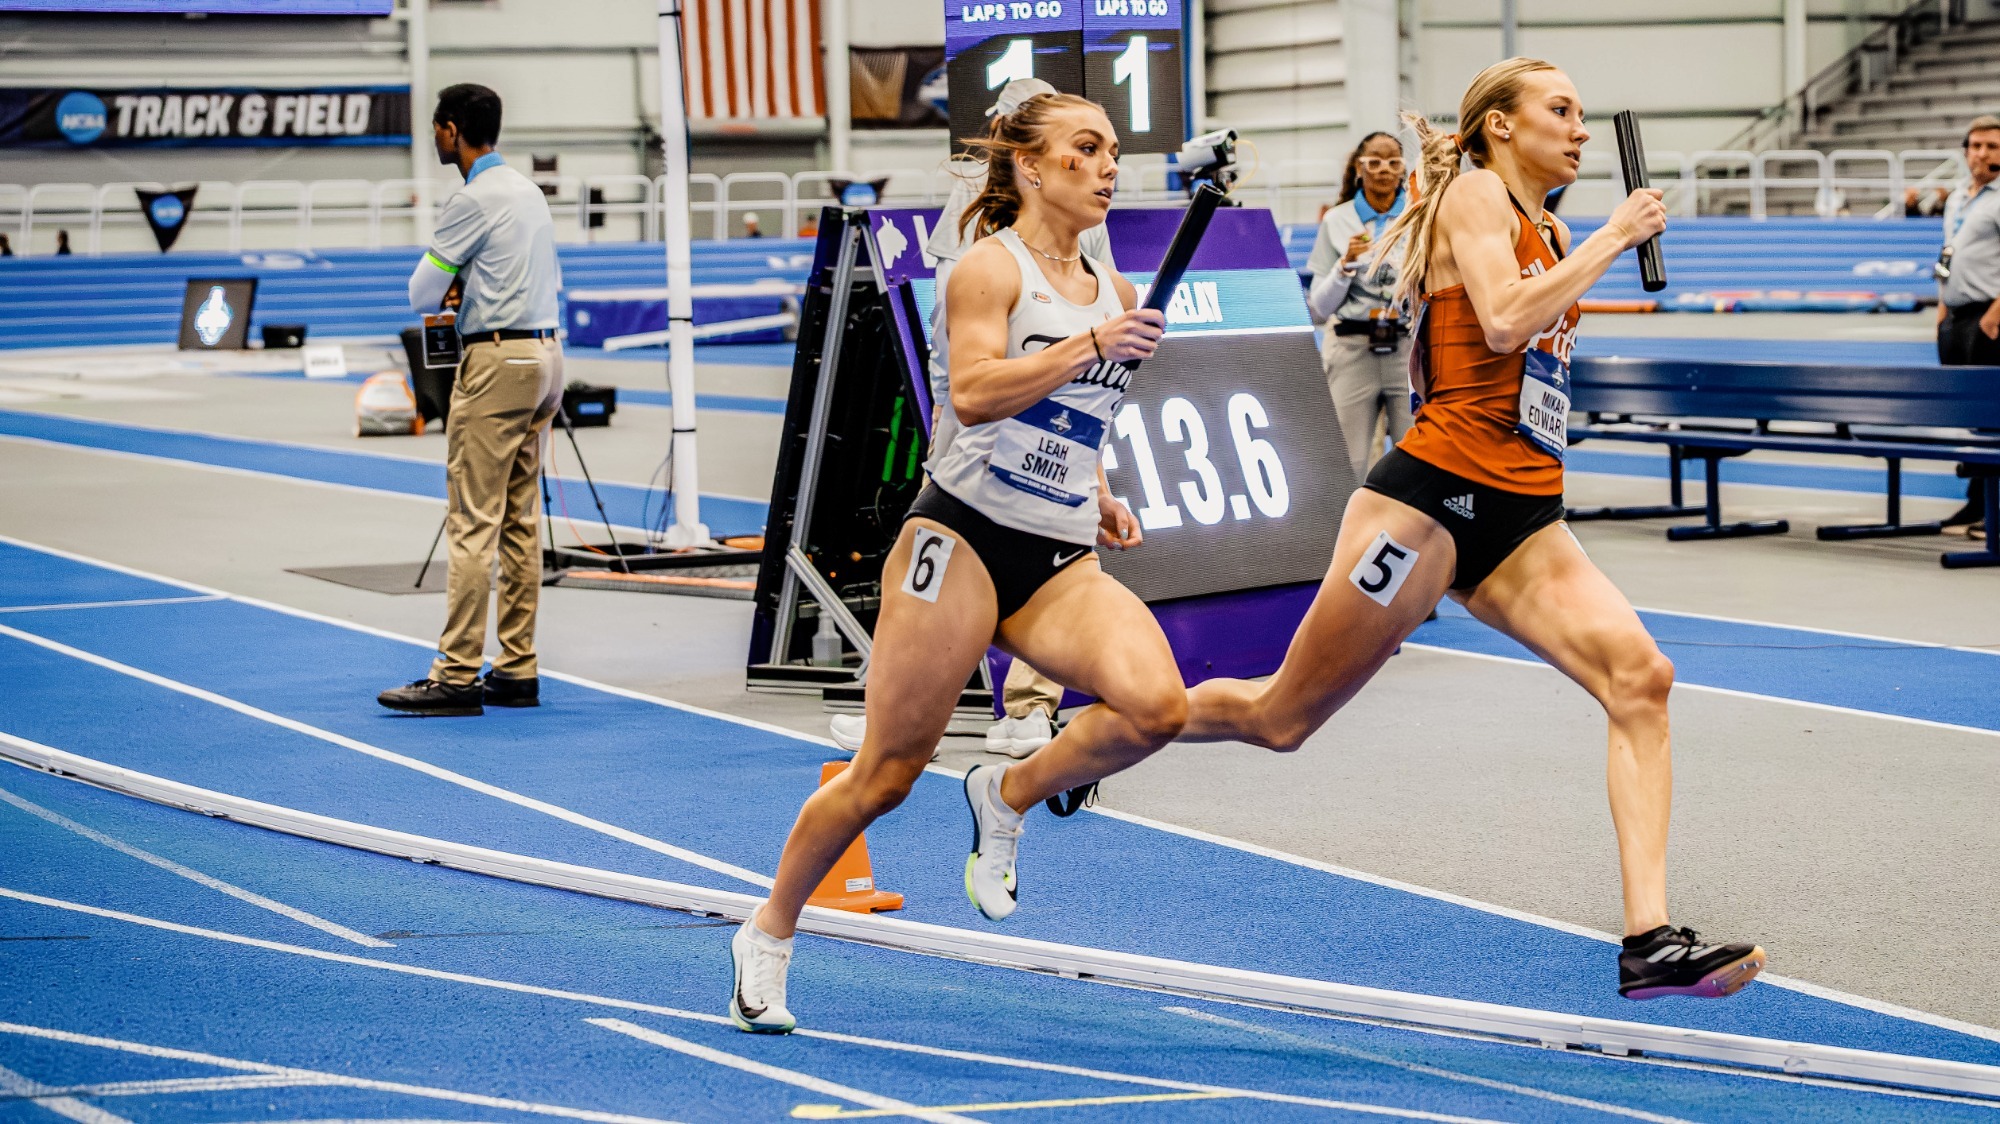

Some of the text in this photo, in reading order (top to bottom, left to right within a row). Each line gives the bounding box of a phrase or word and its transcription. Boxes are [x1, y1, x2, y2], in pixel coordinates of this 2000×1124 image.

[962, 0, 1062, 22] LAPS TO GO
[1095, 0, 1168, 16] LAPS TO GO
[1113, 35, 1151, 132] 1
[114, 94, 371, 137] TRACK & FIELD
[1038, 437, 1069, 461] LEAH
[1022, 453, 1069, 484] SMITH
[1443, 499, 1475, 519] adidas
[912, 536, 944, 592] 6
[1359, 542, 1408, 593] 5
